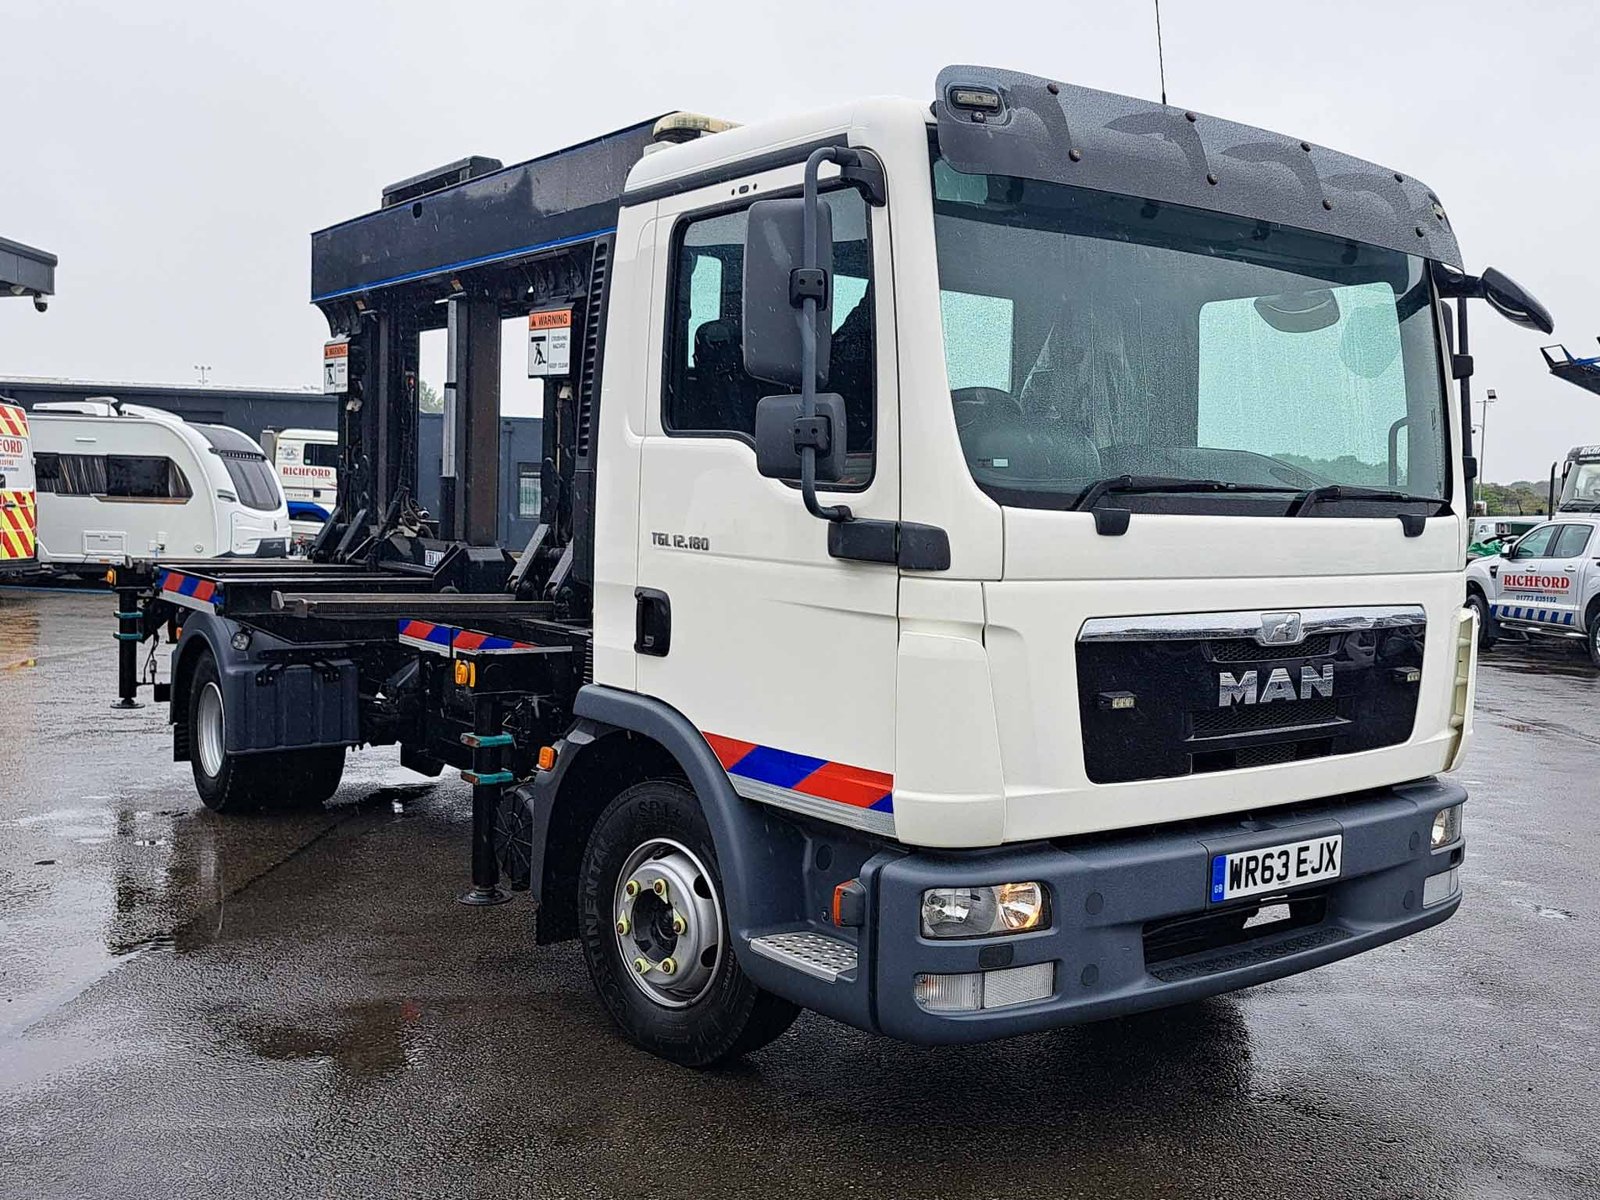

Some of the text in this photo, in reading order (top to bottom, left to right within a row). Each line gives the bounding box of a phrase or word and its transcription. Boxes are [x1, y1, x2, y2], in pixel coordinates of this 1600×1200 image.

[538, 313, 568, 326] WARNING
[283, 466, 331, 477] RICHFORD
[651, 531, 710, 551] TGL 12.180
[1504, 574, 1570, 589] RICHFORD
[1218, 664, 1334, 707] MAN
[1229, 840, 1338, 891] WR63 EJX
[1214, 883, 1223, 894] GB
